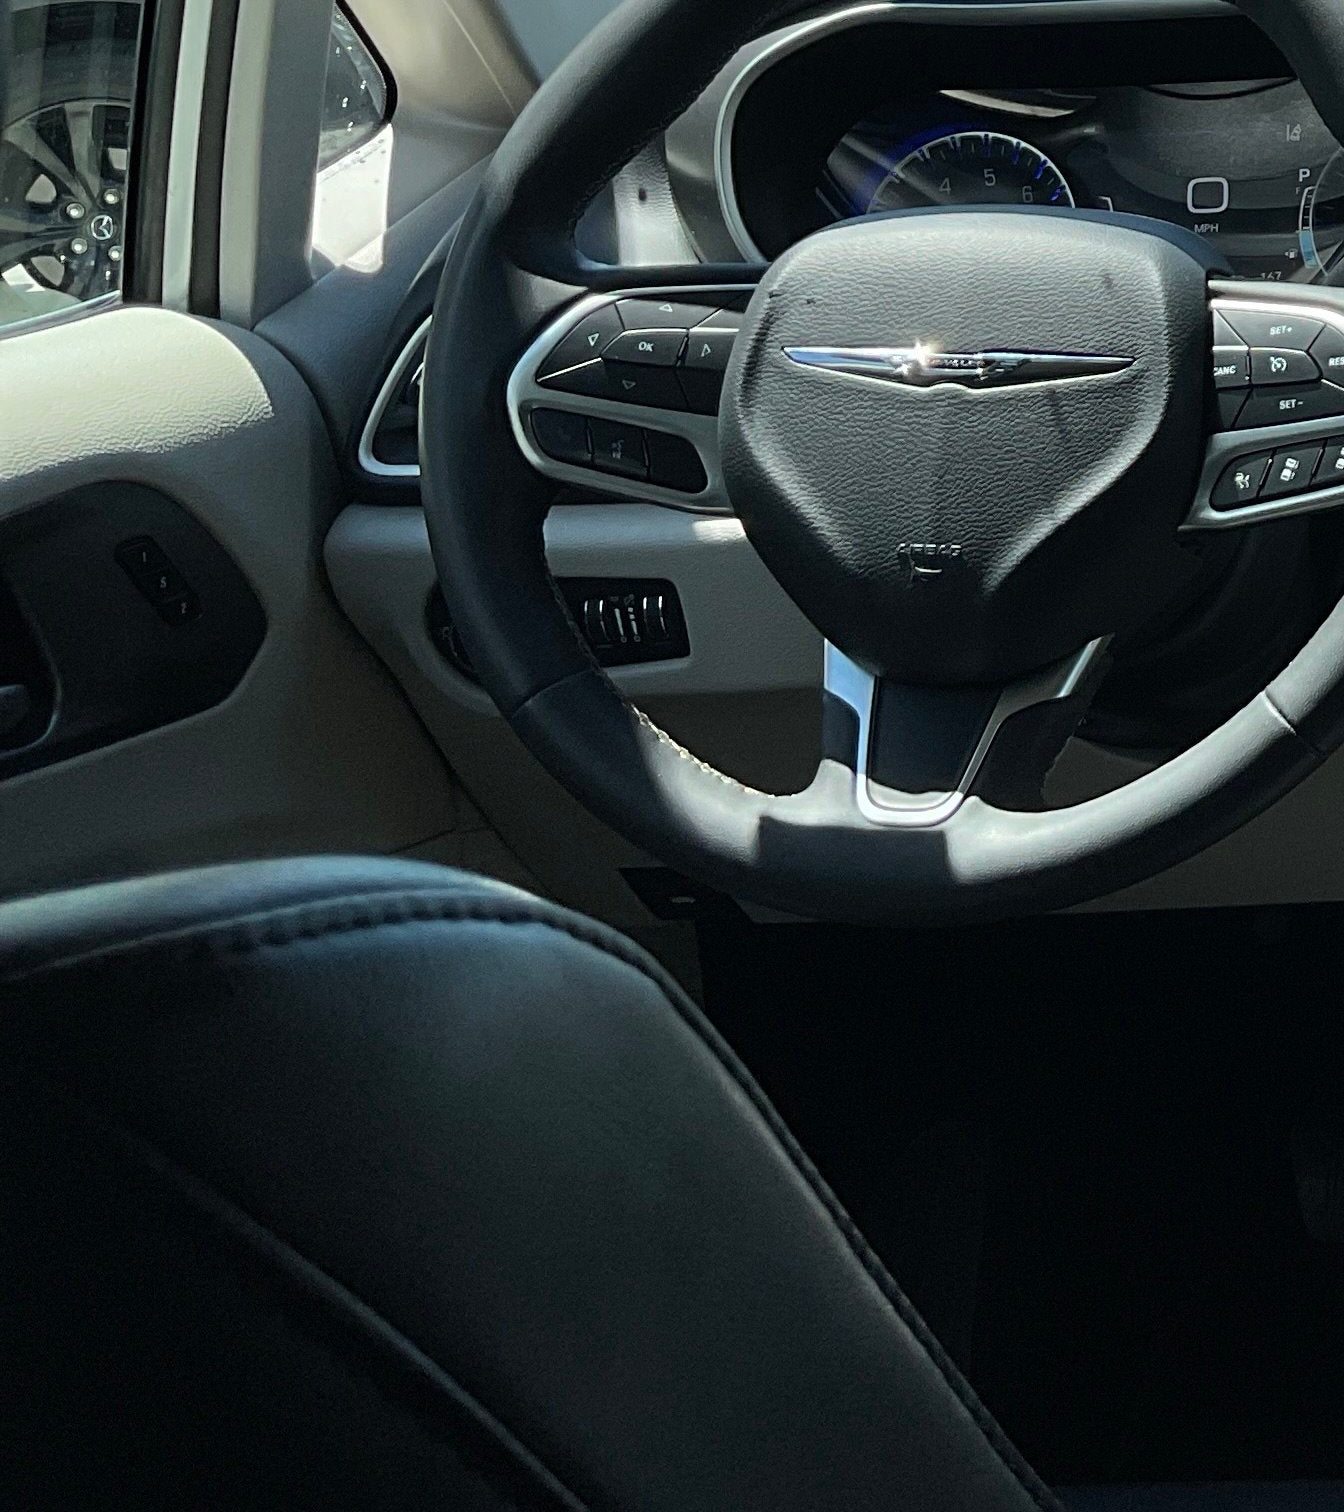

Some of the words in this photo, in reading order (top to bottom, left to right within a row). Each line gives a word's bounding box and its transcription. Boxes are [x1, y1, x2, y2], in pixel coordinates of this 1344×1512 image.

[983, 168, 996, 187] 5
[1298, 168, 1311, 182] P
[939, 178, 951, 194] 4
[1022, 186, 1033, 203] 6
[1194, 223, 1219, 233] MPH
[639, 342, 654, 352] OK
[896, 542, 962, 556] AIRBAG
